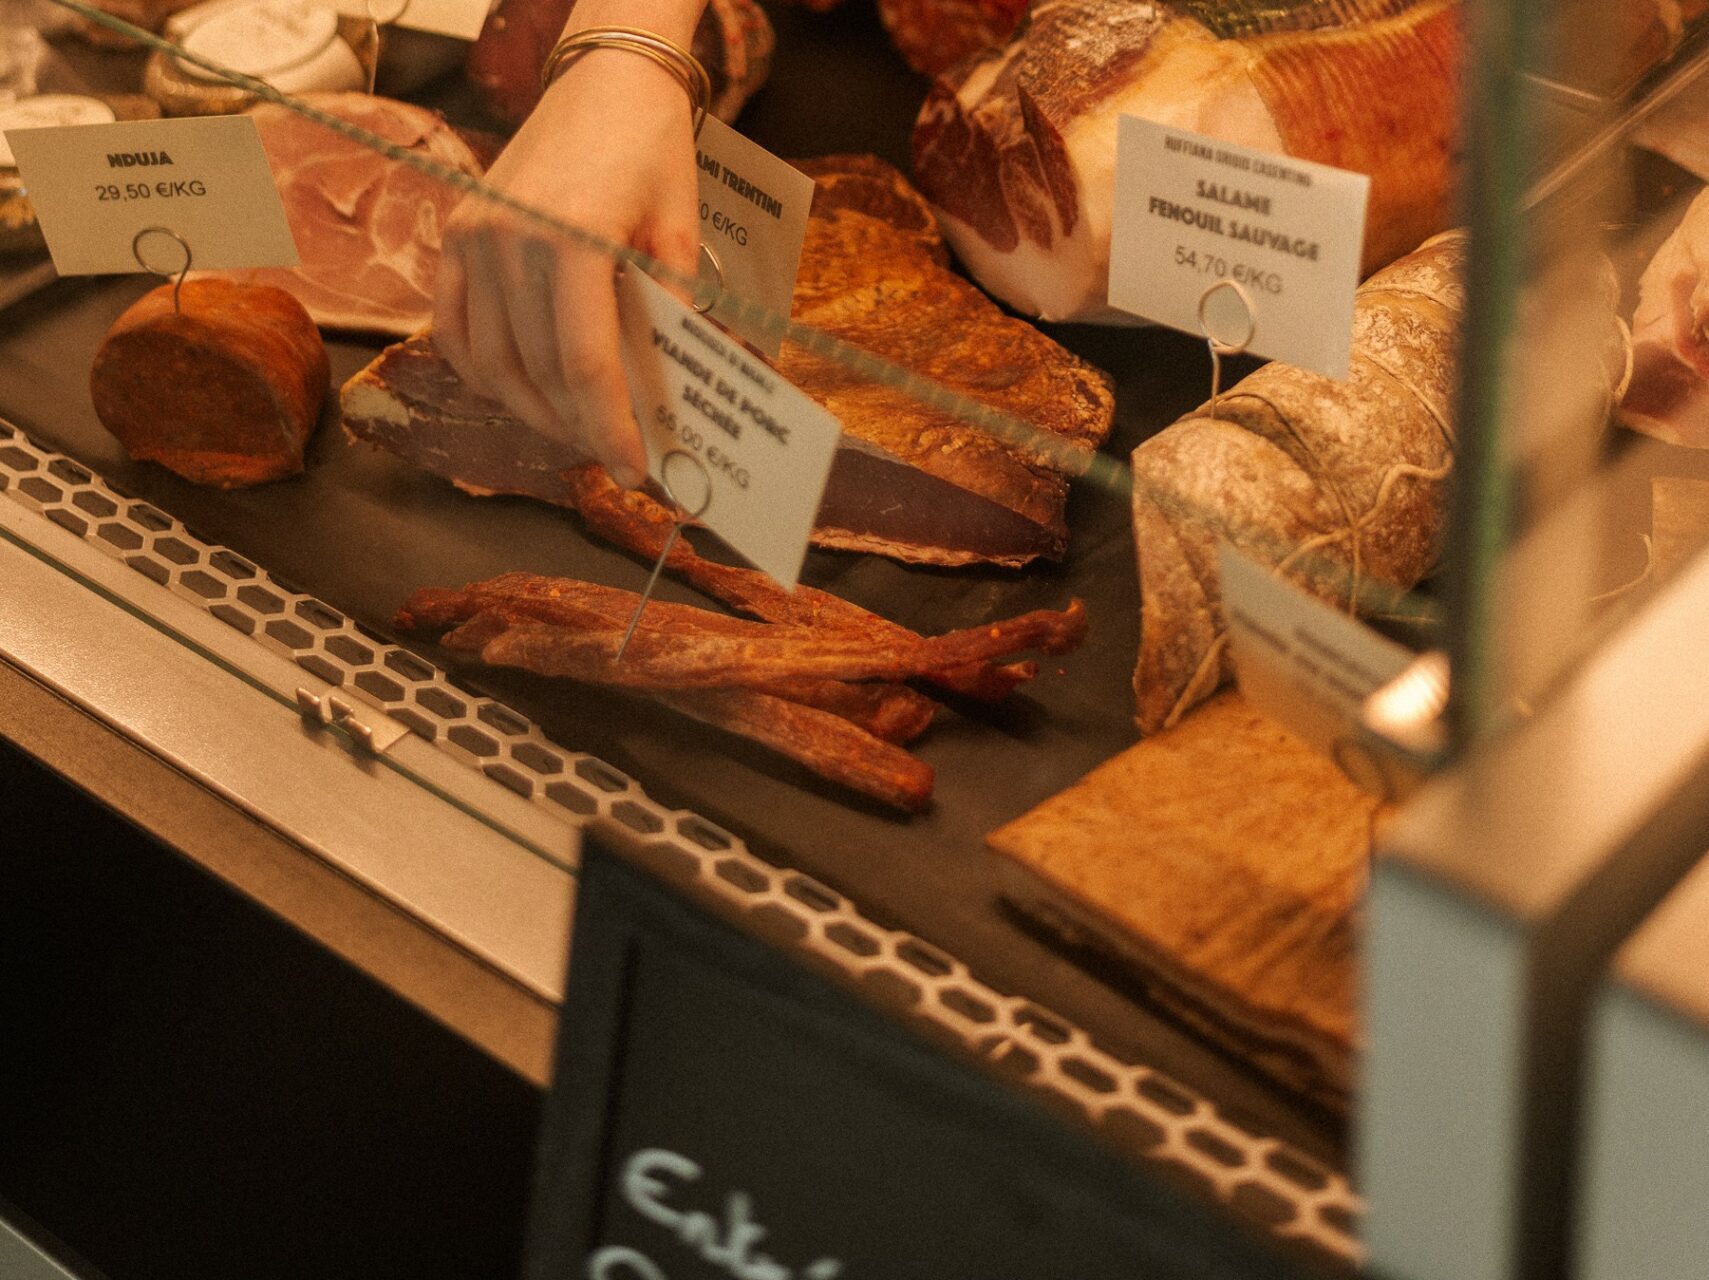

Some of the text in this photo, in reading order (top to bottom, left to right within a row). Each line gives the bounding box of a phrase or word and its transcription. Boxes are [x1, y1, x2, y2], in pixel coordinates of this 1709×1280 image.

[106, 151, 174, 169] NDUJA
[95, 180, 207, 202] 29,50 €/KG
[722, 165, 783, 220] TRENTINI
[1196, 179, 1271, 216] SALAME
[712, 211, 748, 246] €/KG
[1149, 196, 1320, 262] FENOUIL SAUVAGE
[1174, 245, 1283, 296] 54,70 €/KG
